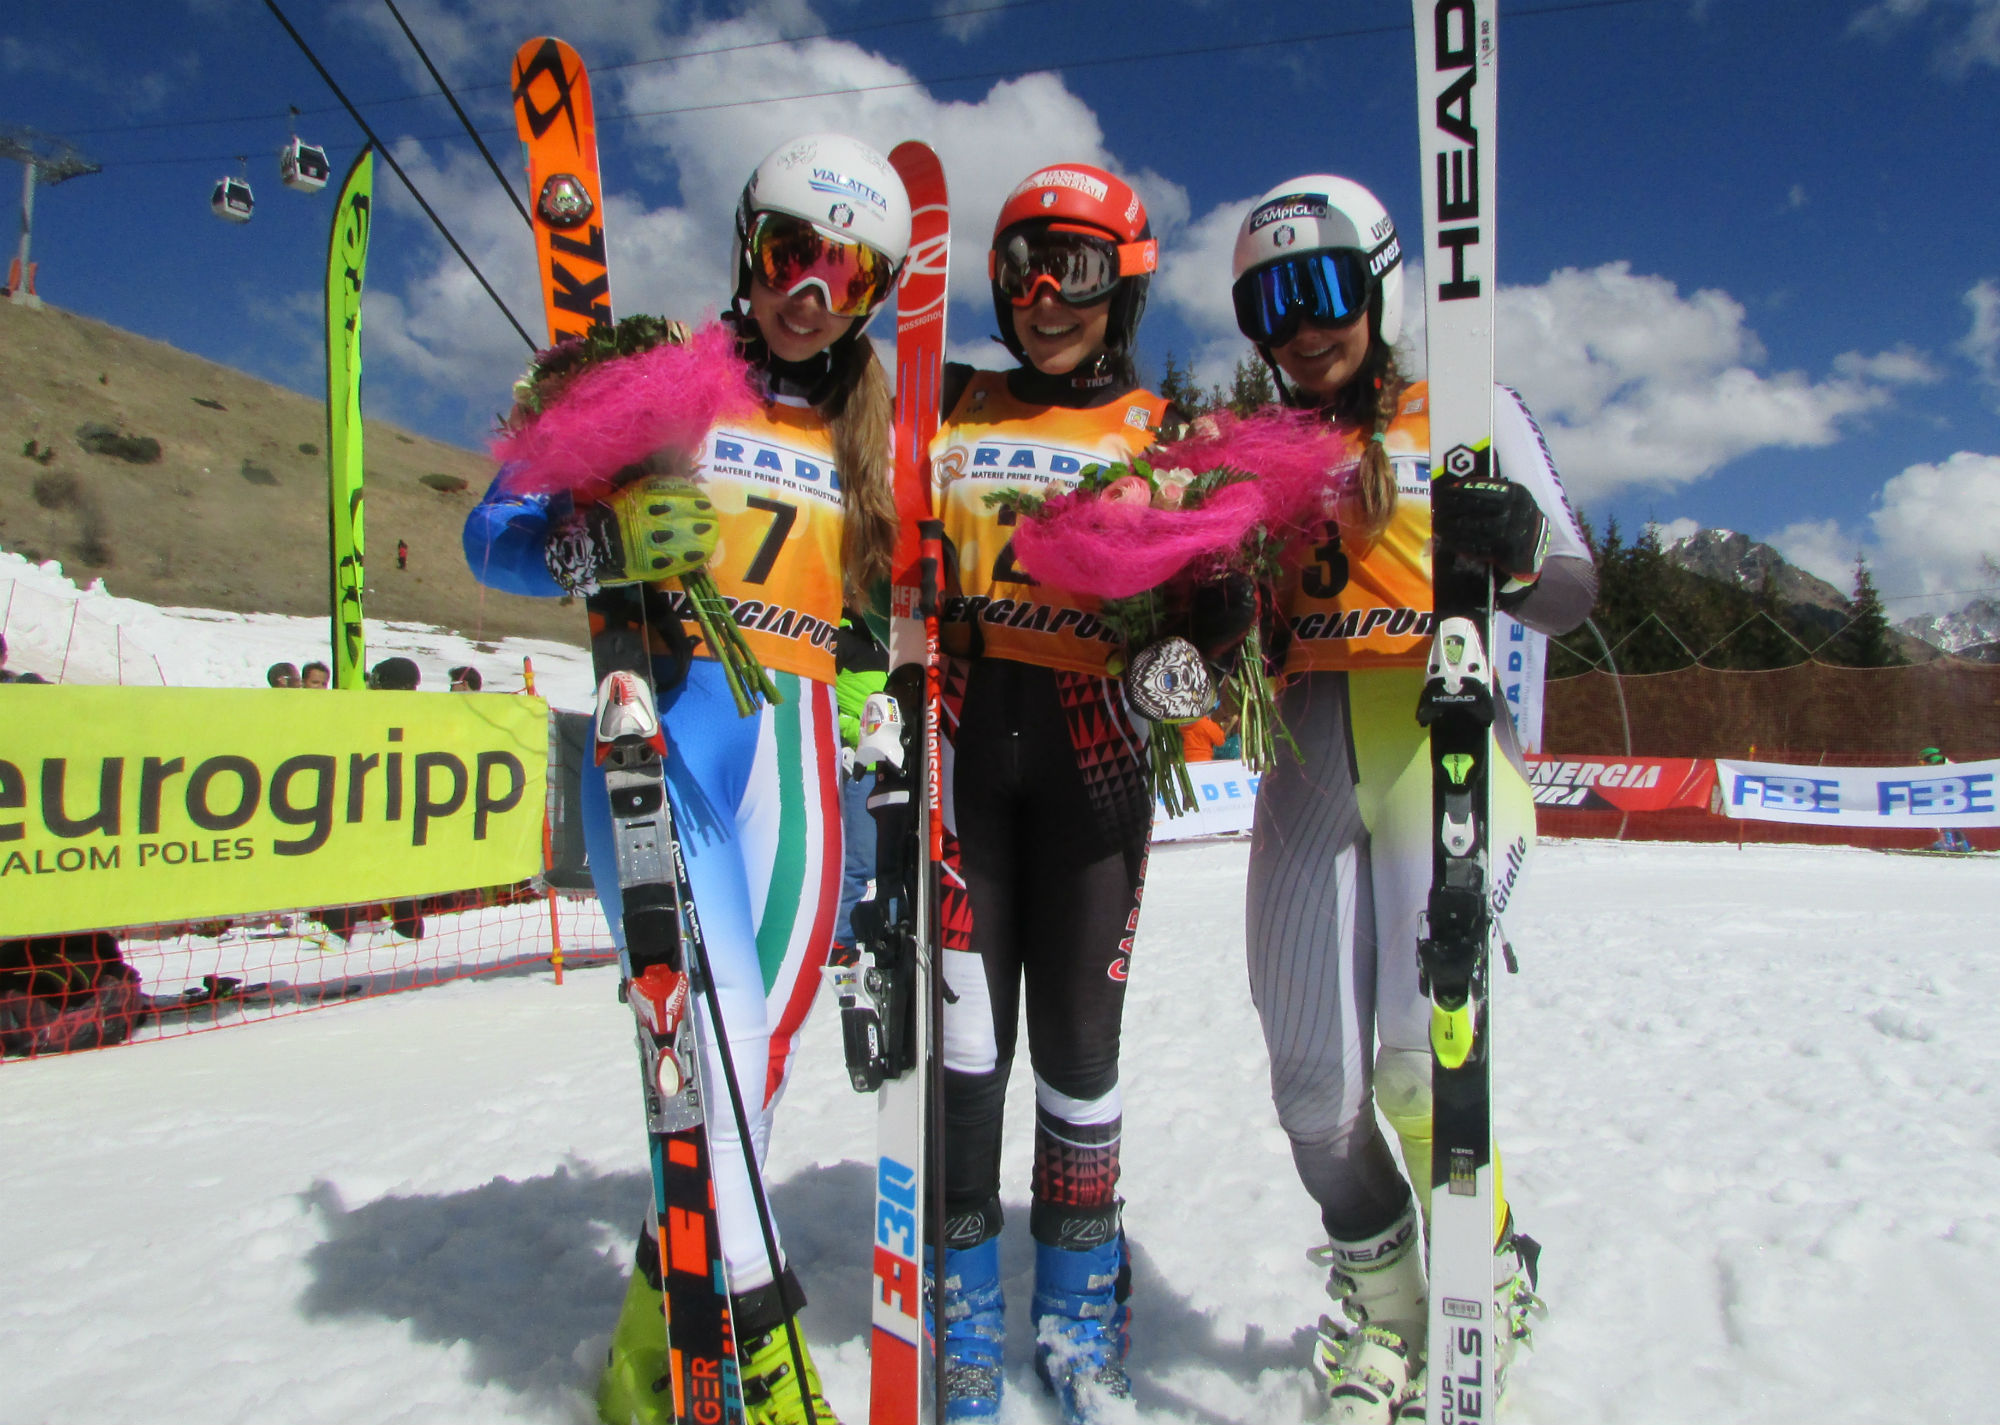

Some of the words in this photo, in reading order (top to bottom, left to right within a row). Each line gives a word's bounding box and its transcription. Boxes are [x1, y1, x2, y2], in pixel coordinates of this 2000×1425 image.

[1434, 0, 1480, 302] HEAD
[1369, 236, 1401, 277] uvex
[898, 310, 943, 334] ROSSIGNOL
[713, 464, 752, 479] MATERIE
[754, 472, 780, 485] PRIME
[783, 478, 797, 490] PER
[971, 471, 1004, 480] MATERIE
[1007, 472, 1031, 481] PRIME
[1034, 474, 1050, 484] PER
[1463, 481, 1509, 493] LEKI
[742, 494, 798, 585] 7
[1302, 520, 1349, 599] 3
[1432, 694, 1476, 704] HEAD
[1732, 774, 1840, 814] FEBE
[1876, 773, 1995, 816] FEBE
[138, 837, 255, 867] POLES
[1491, 835, 1527, 914] Gialle
[665, 980, 689, 1017] MARKER
[1458, 1327, 1482, 1425] ELS
